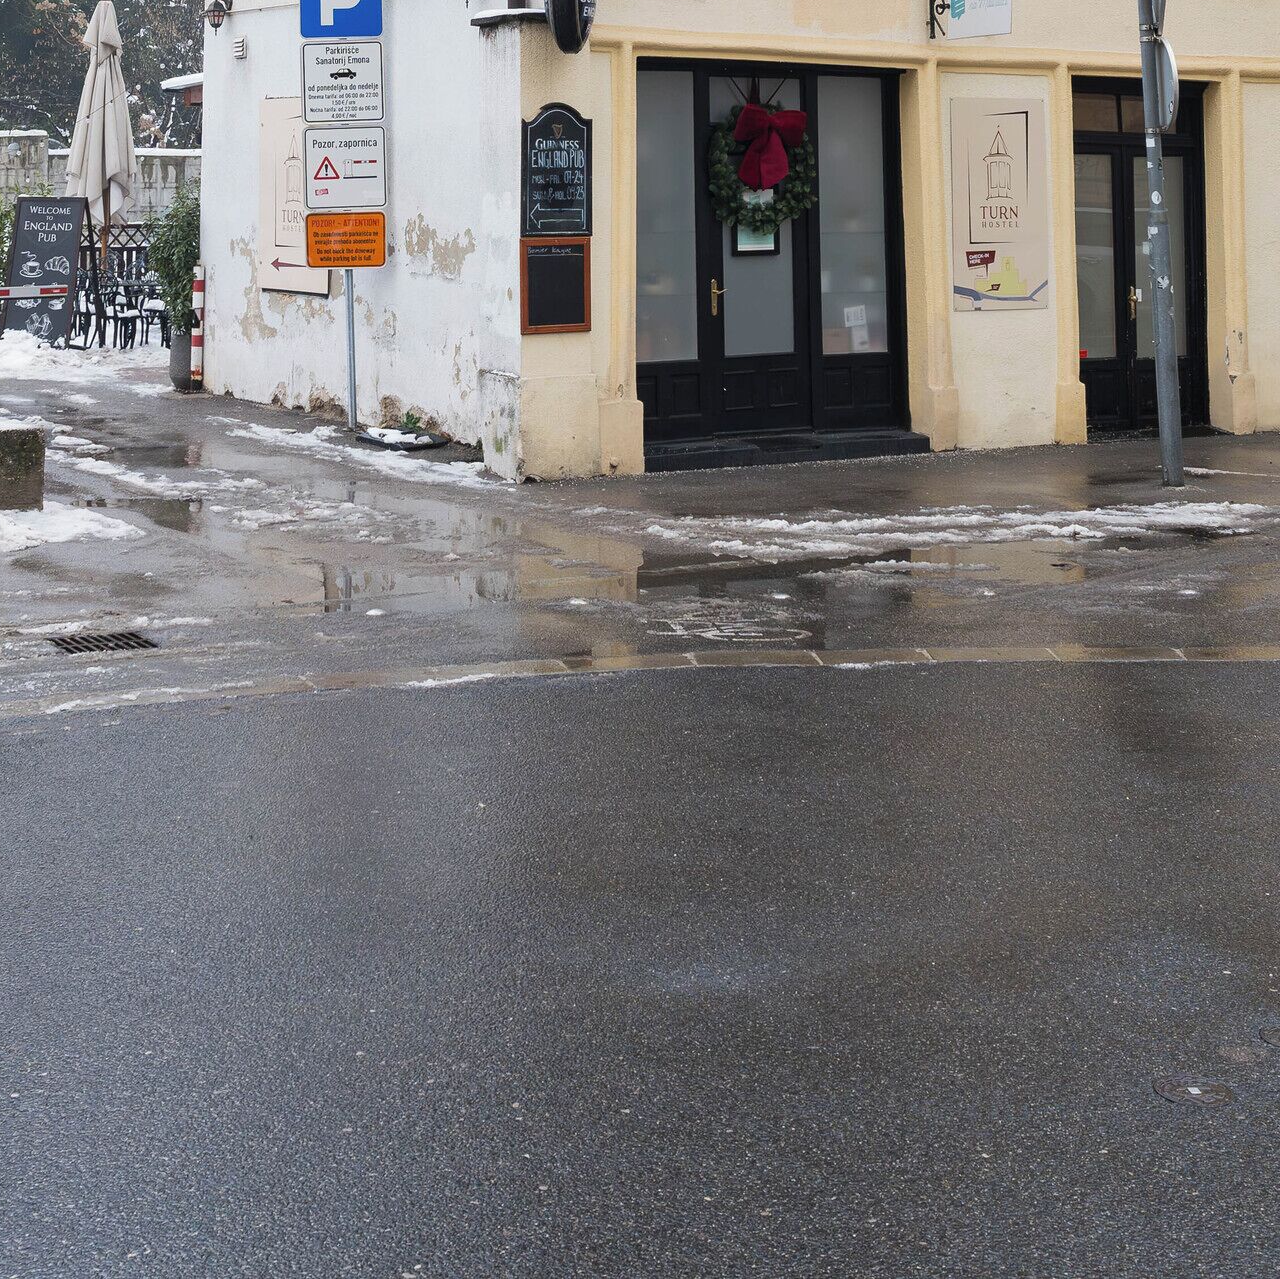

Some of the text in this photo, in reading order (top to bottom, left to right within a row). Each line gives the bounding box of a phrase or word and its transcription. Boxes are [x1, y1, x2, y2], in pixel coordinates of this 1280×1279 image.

[315, 56, 370, 66] Sanatorij Emona
[339, 138, 378, 150] zapornica
[531, 149, 585, 168] ENGLAND PUB
[30, 205, 72, 215] WELCOME
[980, 205, 1019, 220] TURN
[282, 209, 305, 224] TURN
[24, 220, 73, 232] ENGLAND
[981, 220, 1019, 228] HOSTEL
[38, 232, 57, 243] PUB
[968, 253, 990, 261] CHECK-IN
